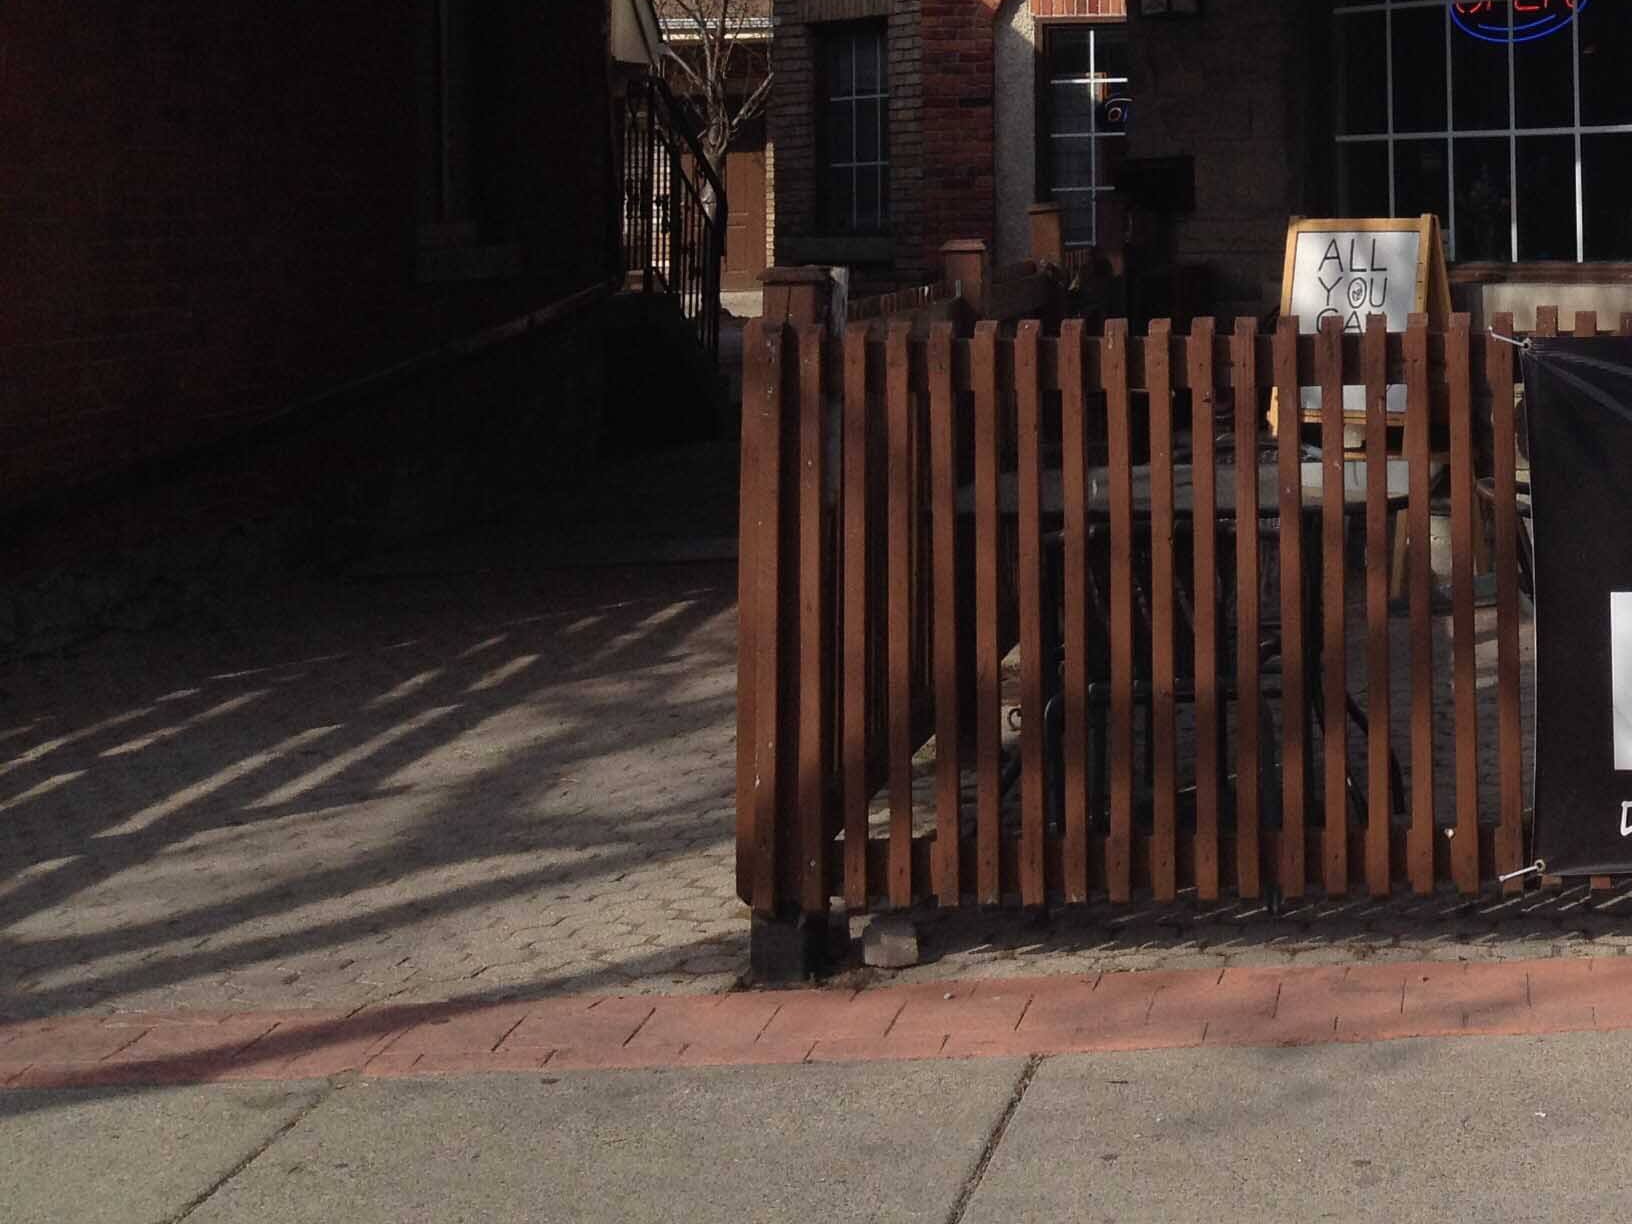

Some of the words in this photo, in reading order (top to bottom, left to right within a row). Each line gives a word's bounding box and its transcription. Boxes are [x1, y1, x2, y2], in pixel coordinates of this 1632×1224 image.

[1318, 238, 1387, 272] ALL
[1318, 276, 1388, 308] YOU
[1316, 308, 1387, 336] CA
